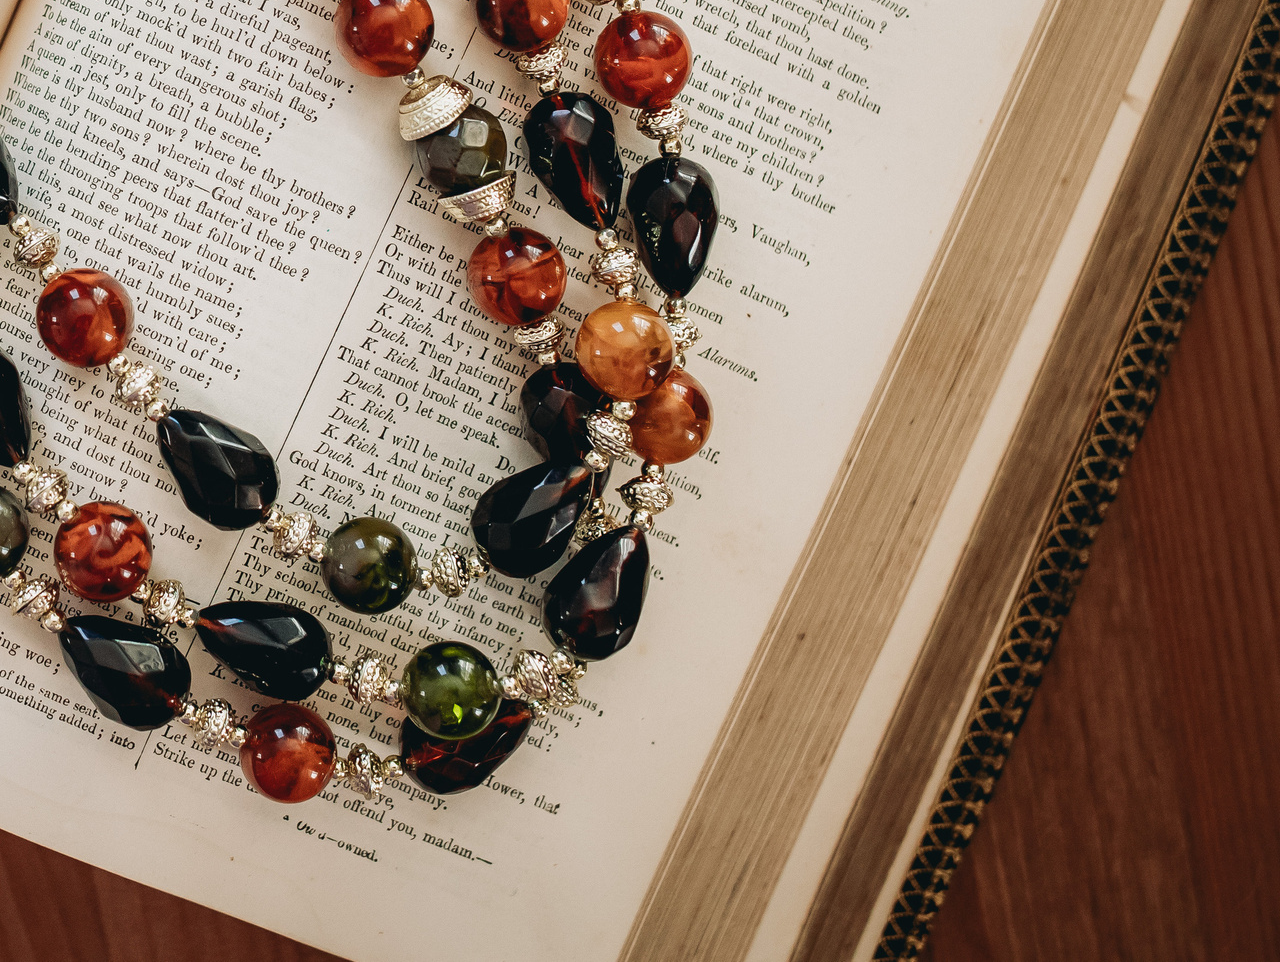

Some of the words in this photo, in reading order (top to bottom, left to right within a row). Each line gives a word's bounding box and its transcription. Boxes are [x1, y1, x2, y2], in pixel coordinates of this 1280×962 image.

[752, 223, 810, 267] Vaughan,
[697, 347, 758, 382] Alarums.
[343, 371, 385, 399] Duch.
[395, 392, 409, 413] O,
[415, 399, 434, 419] let
[436, 413, 458, 430] me
[460, 424, 500, 449] speak.
[14, 674, 35, 691] the
[38, 687, 71, 707] same
[72, 702, 107, 720] seat.
[153, 741, 196, 769] Strike
[199, 763, 218, 781] up
[221, 769, 243, 787] the
[343, 799, 386, 824] offend
[386, 818, 417, 841] you,
